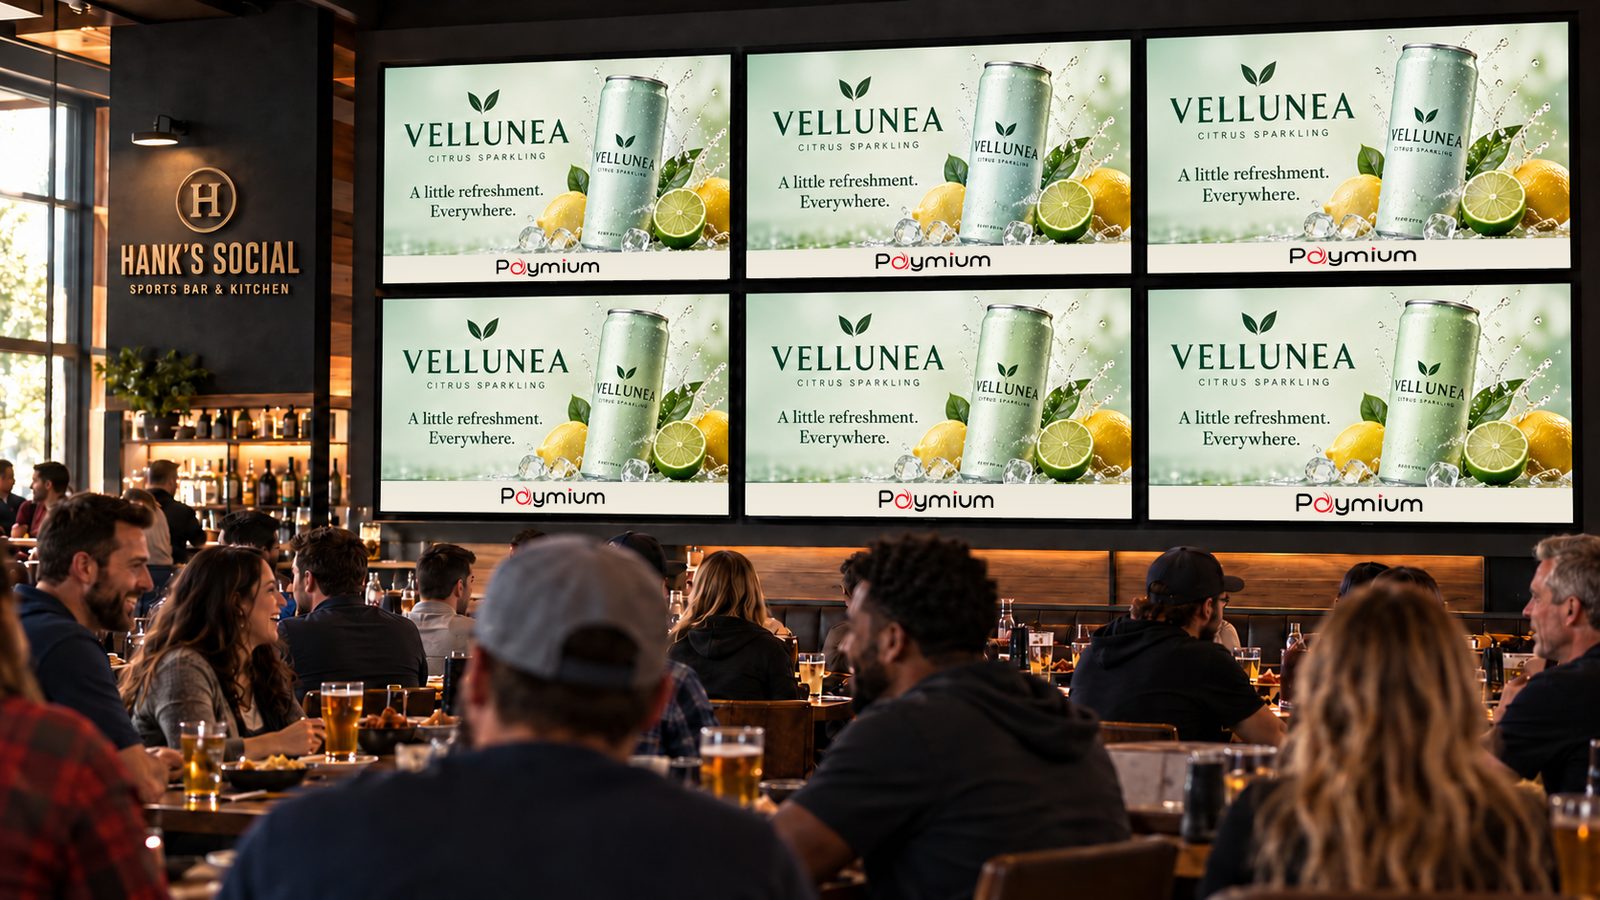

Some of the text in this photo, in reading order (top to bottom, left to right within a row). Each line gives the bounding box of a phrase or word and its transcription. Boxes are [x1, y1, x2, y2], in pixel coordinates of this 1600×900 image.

[1170, 93, 1354, 123] VELLUNEA
[773, 107, 943, 136] VELLUNEA
[405, 119, 569, 147] VELLUNEA
[1198, 129, 1328, 140] CITRUS SPARKLING
[1391, 128, 1462, 148] VELLUNEA
[798, 141, 919, 151] CITRUS SPARKLING
[975, 140, 1038, 160] VELLUNEA
[429, 152, 545, 163] CITRUS SPARKLING
[595, 152, 655, 171] VELLUNEA
[779, 174, 917, 189] A little refreshment.
[1178, 165, 1328, 182] A little refreshment.
[190, 183, 221, 217] H
[410, 184, 543, 198] A little refreshment.
[1203, 187, 1299, 205] Everywhere.
[431, 203, 515, 221] Everywhere.
[801, 194, 889, 212] Everywhere.
[121, 241, 300, 275] HANK'S SOCIAL
[876, 253, 990, 272] Paymium
[1290, 247, 1416, 266] Paymium
[496, 259, 599, 277] Paymium
[130, 284, 289, 295] SPORTS BAR & KITCHEN
[403, 349, 568, 373] VELLUNEA
[772, 345, 944, 371] VELLUNEA
[1171, 343, 1355, 370] VELLUNEA
[477, 381, 545, 389] SPARKLING
[797, 379, 919, 387] CITRUS SPARKLING
[977, 380, 1039, 400] VELLUNEA
[1199, 378, 1329, 386] CITRUS SPARKLING
[1395, 379, 1465, 401] VELLUNEA
[597, 382, 655, 402] VELLUNEA
[408, 411, 542, 425] A little refreshment.
[778, 410, 918, 423] A little refreshment.
[1179, 410, 1330, 424] A little refreshment.
[430, 431, 514, 448] Everywhere.
[800, 430, 889, 448] Everywhere.
[1204, 431, 1299, 449] Everywhere.
[501, 488, 605, 508] Paymium
[879, 490, 993, 512] Paymium
[1296, 493, 1422, 516] Paymium
